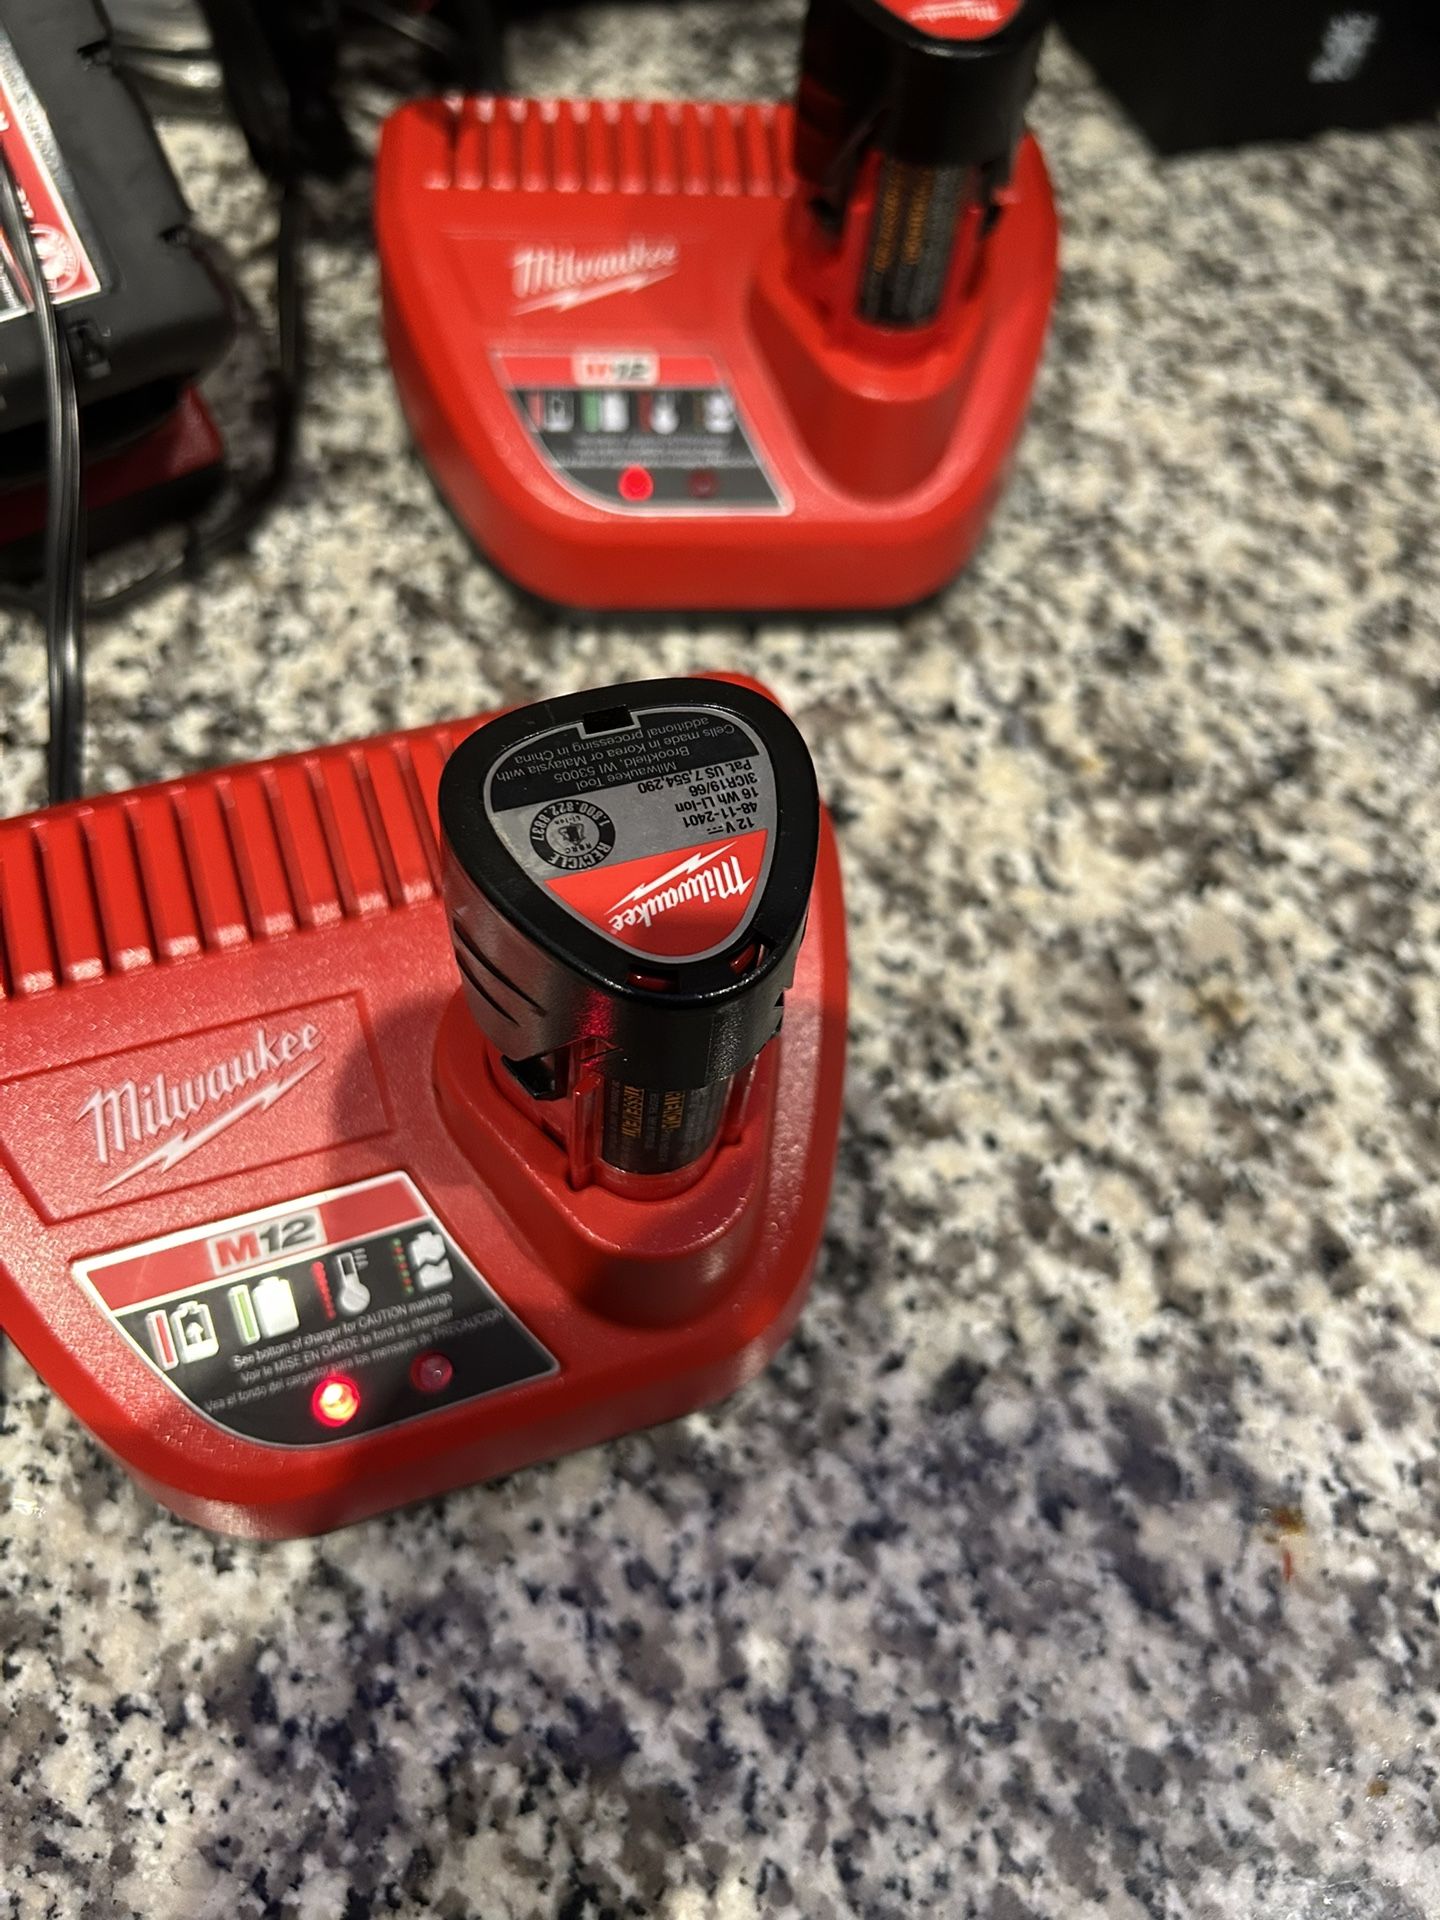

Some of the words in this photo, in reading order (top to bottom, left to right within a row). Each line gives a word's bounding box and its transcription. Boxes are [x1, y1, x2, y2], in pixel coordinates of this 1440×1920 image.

[648, 717, 710, 736] additional
[703, 723, 735, 738] Cells
[572, 729, 644, 751] processing
[649, 737, 663, 749] in
[664, 731, 700, 745] made
[514, 749, 555, 764] China
[557, 748, 570, 756] in
[590, 752, 603, 760] or
[607, 742, 647, 757] Korea
[619, 745, 690, 768] Brookfield,
[528, 755, 587, 775] Malaysia
[599, 761, 618, 773] WI
[607, 761, 677, 783] Milwaukee
[705, 765, 725, 779] US
[724, 759, 753, 773] Pat.
[496, 767, 526, 782] with
[554, 766, 596, 783] 53005
[638, 769, 703, 794] 7,554,290
[576, 776, 605, 791] Tool
[689, 772, 758, 797] 3ICR19/66
[717, 790, 741, 804] Wh
[742, 786, 759, 799] 16
[683, 802, 758, 828] 48-11-2401
[736, 817, 756, 831] 12
[549, 841, 613, 869] RECYCLE
[608, 855, 754, 932] Milwaukee
[75, 1023, 322, 1164] Milwaukee
[214, 1215, 318, 1268] M12
[232, 1355, 255, 1369] See
[255, 1341, 291, 1362] bottom
[304, 1325, 342, 1345] charger
[358, 1304, 408, 1329] CAUTION
[408, 1291, 453, 1313] markings
[274, 1354, 303, 1373] MISE
[303, 1349, 321, 1364] EN
[322, 1336, 361, 1357] GARDE
